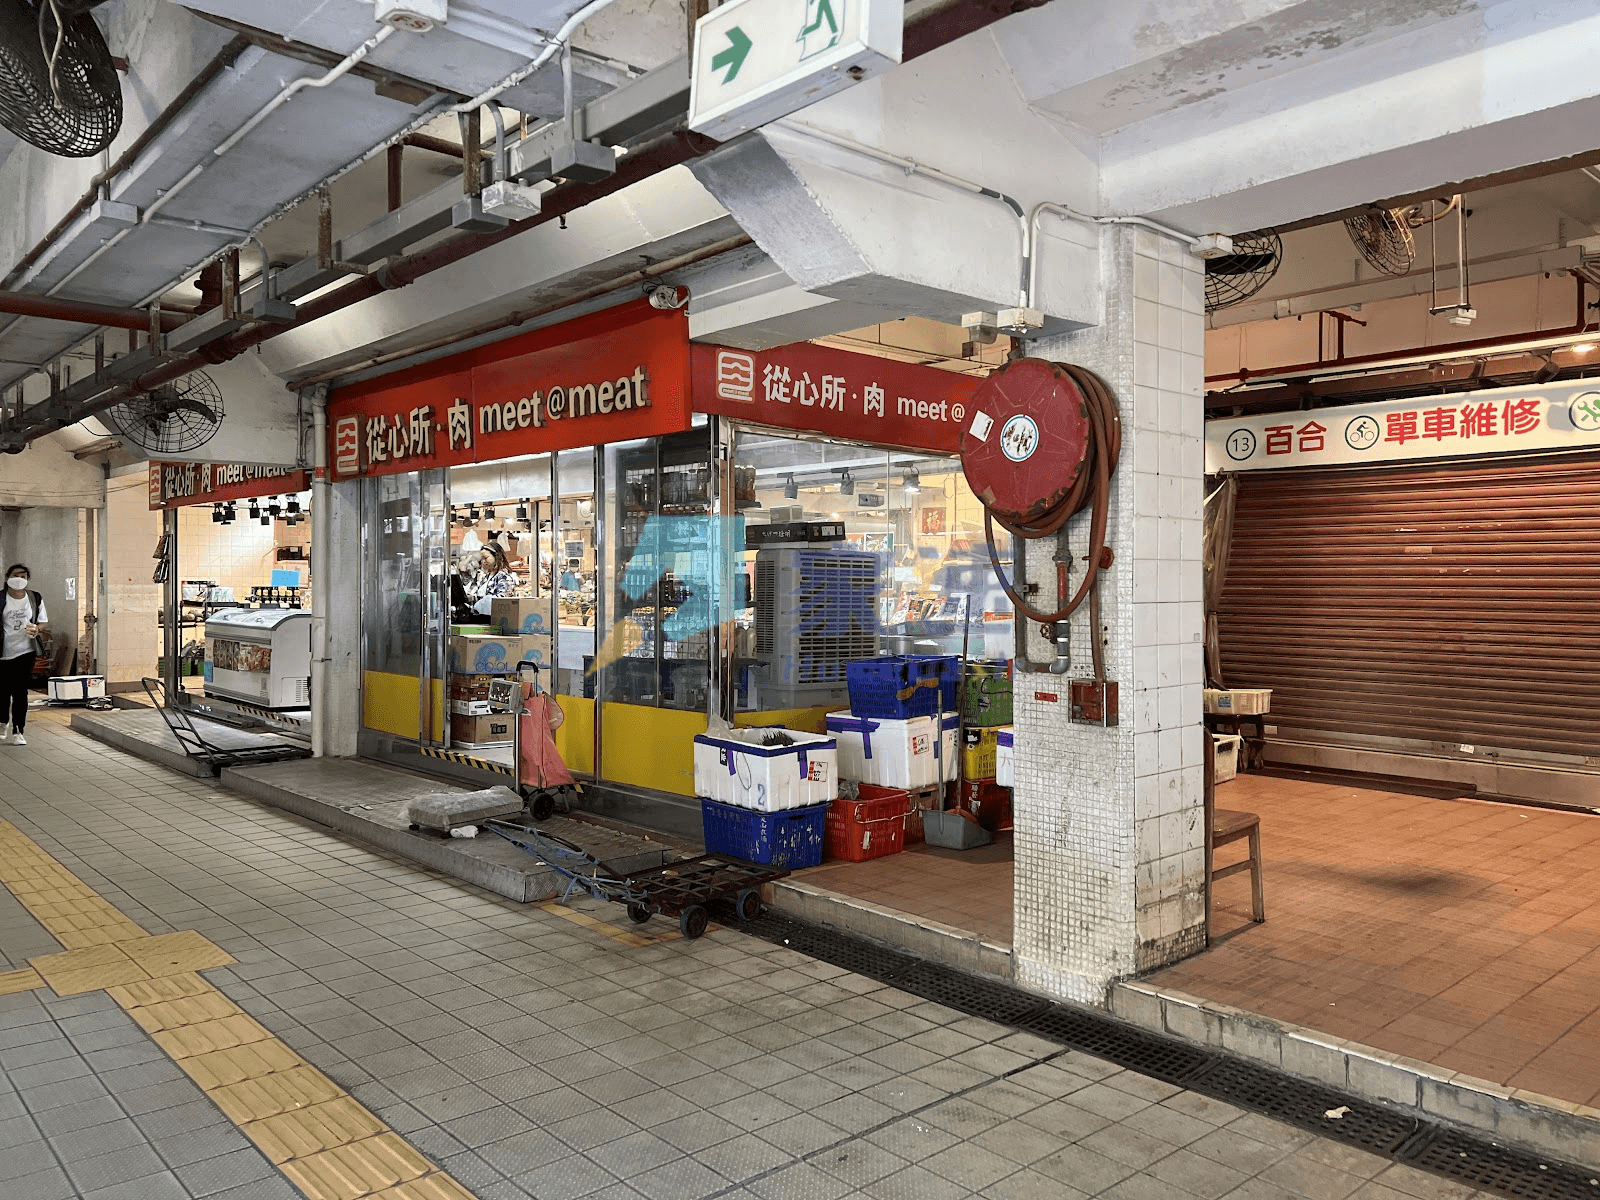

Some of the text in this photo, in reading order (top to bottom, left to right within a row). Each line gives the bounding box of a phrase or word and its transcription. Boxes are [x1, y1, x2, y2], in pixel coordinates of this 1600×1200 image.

[1232, 398, 1541, 455] 13 百合 單車維修
[757, 783, 766, 806] 2
